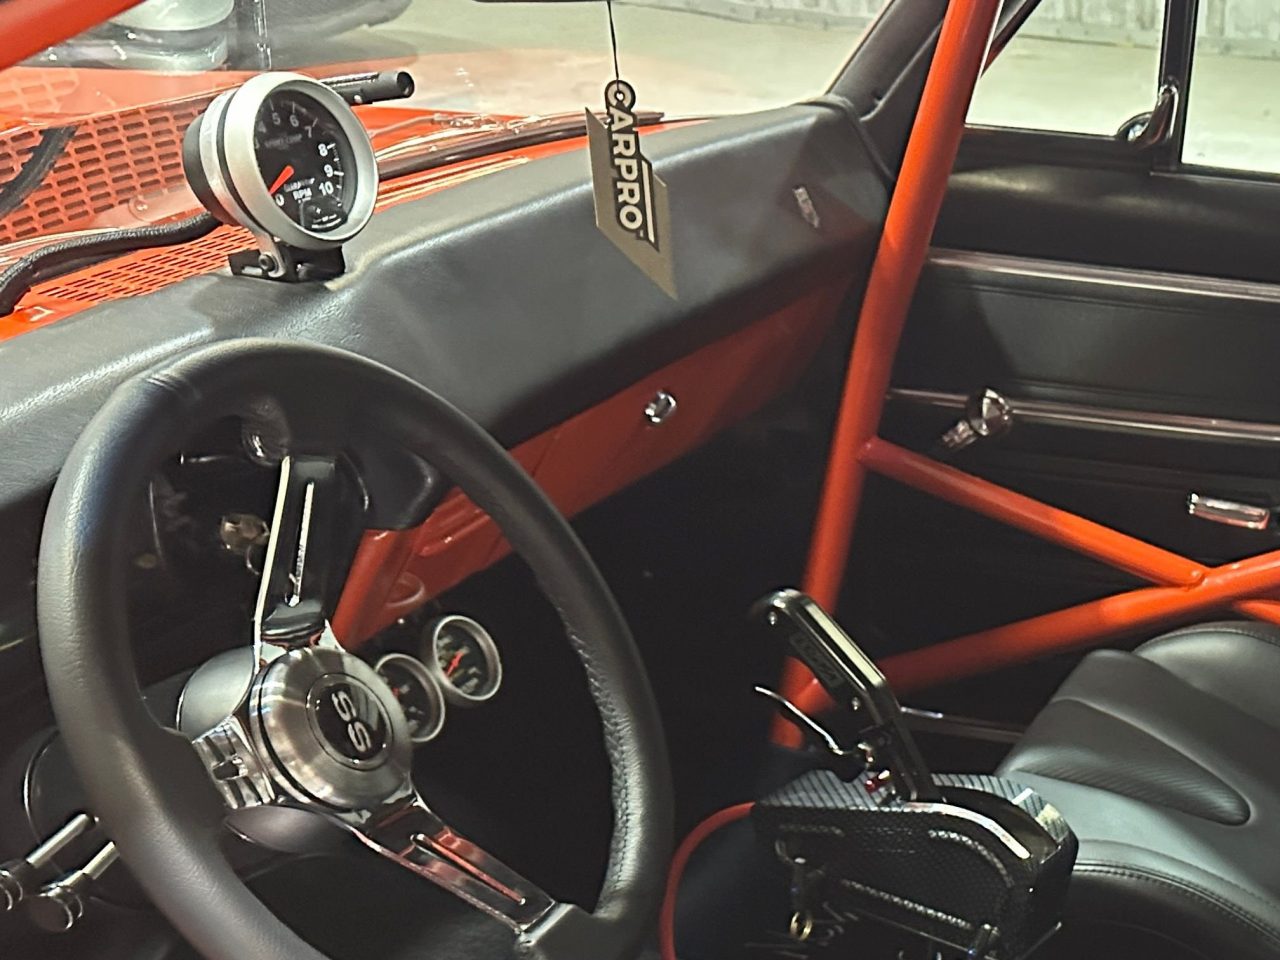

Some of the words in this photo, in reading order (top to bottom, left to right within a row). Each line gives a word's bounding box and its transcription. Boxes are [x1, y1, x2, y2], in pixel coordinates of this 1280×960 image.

[272, 112, 281, 126] 5
[290, 114, 299, 127] 6
[304, 125, 312, 138] 7
[318, 143, 328, 157] 8
[605, 81, 643, 230] CARPRO
[324, 164, 333, 177] 9
[318, 181, 334, 196] 10
[275, 193, 285, 206] 0
[331, 690, 372, 753] SS
